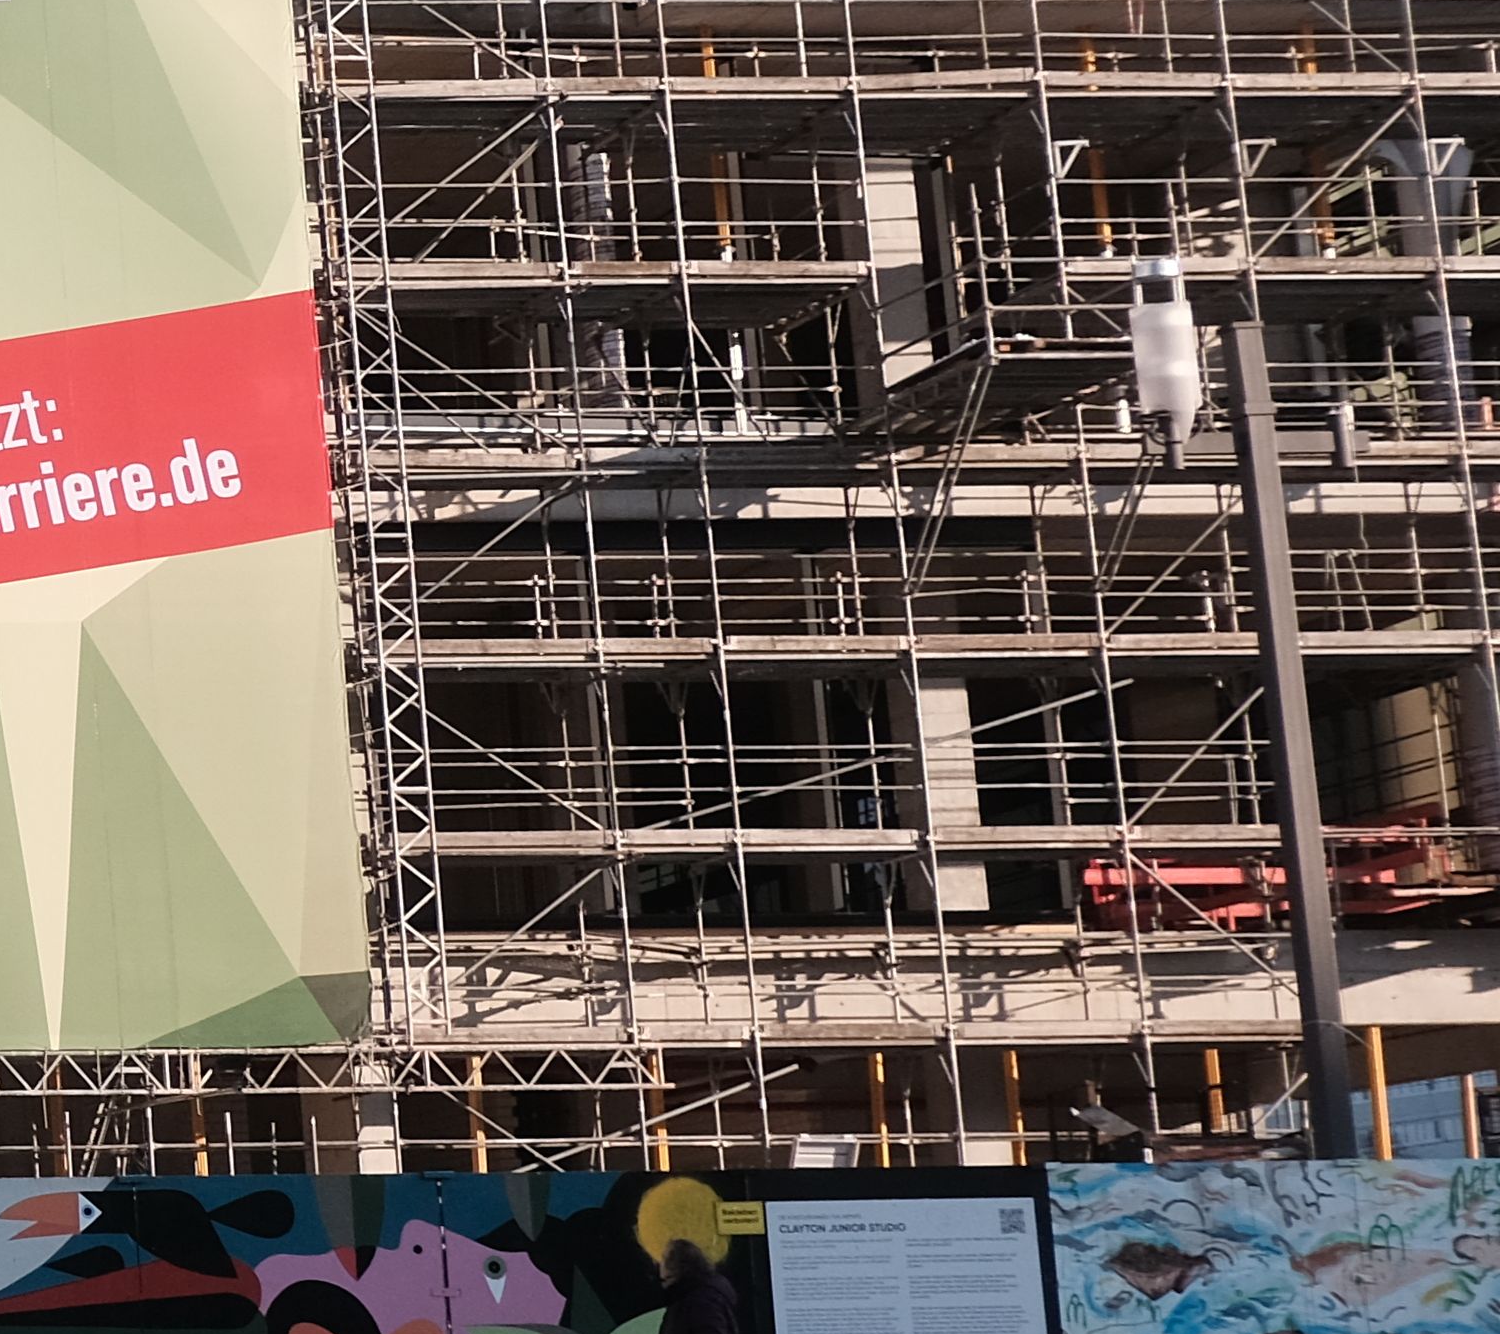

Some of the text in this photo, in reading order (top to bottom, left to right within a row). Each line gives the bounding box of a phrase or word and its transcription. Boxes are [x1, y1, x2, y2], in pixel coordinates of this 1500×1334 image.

[779, 1222, 907, 1234] CLAYTON JUNIOR STUDIO
